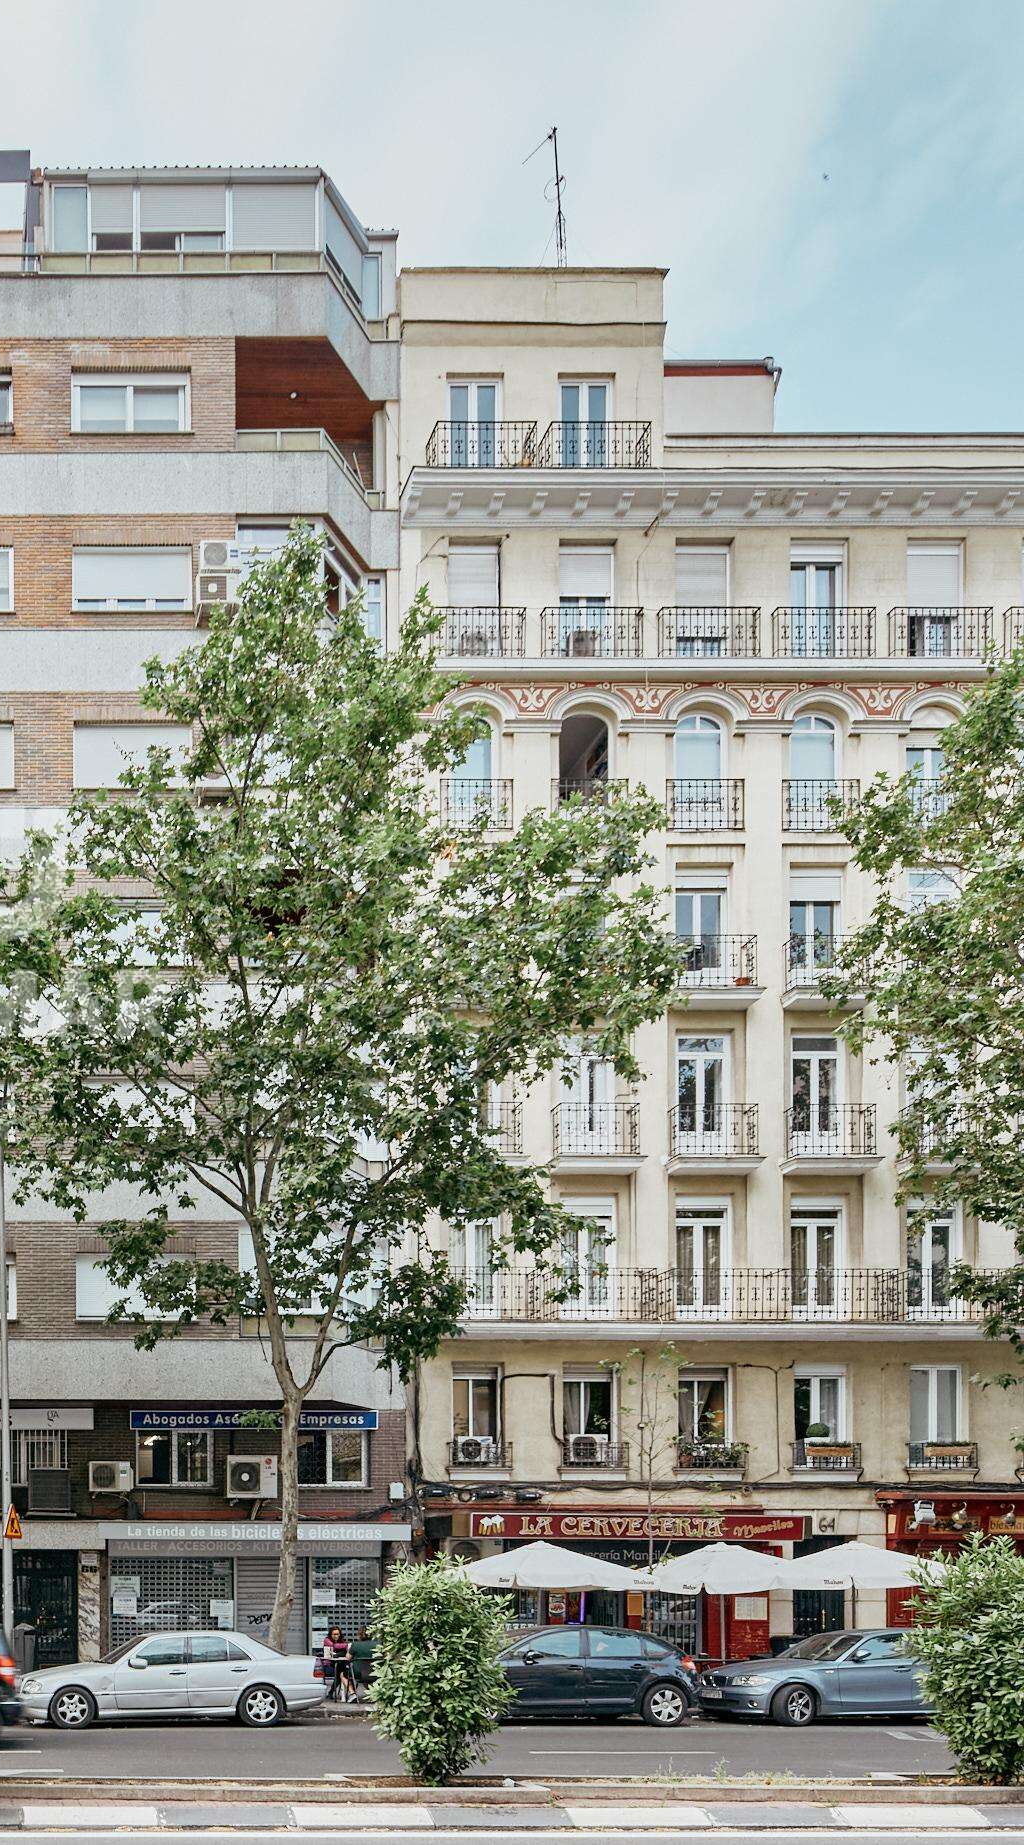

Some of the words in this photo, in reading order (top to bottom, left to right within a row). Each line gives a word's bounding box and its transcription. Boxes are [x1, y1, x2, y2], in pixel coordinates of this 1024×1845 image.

[143, 1413, 209, 1426] Abogados
[300, 1414, 365, 1426] Empresas
[128, 1526, 142, 1537] La
[147, 1525, 186, 1537] tienda
[190, 1526, 205, 1537] de
[210, 1526, 228, 1537] las
[232, 1524, 304, 1539] bicicles
[308, 1524, 382, 1539] eléctricas
[519, 1516, 553, 1535] LA
[819, 1517, 835, 1532] 64
[117, 1541, 158, 1551] TALLER
[167, 1541, 242, 1551] ACCESORIOS
[253, 1541, 270, 1551] KIT
